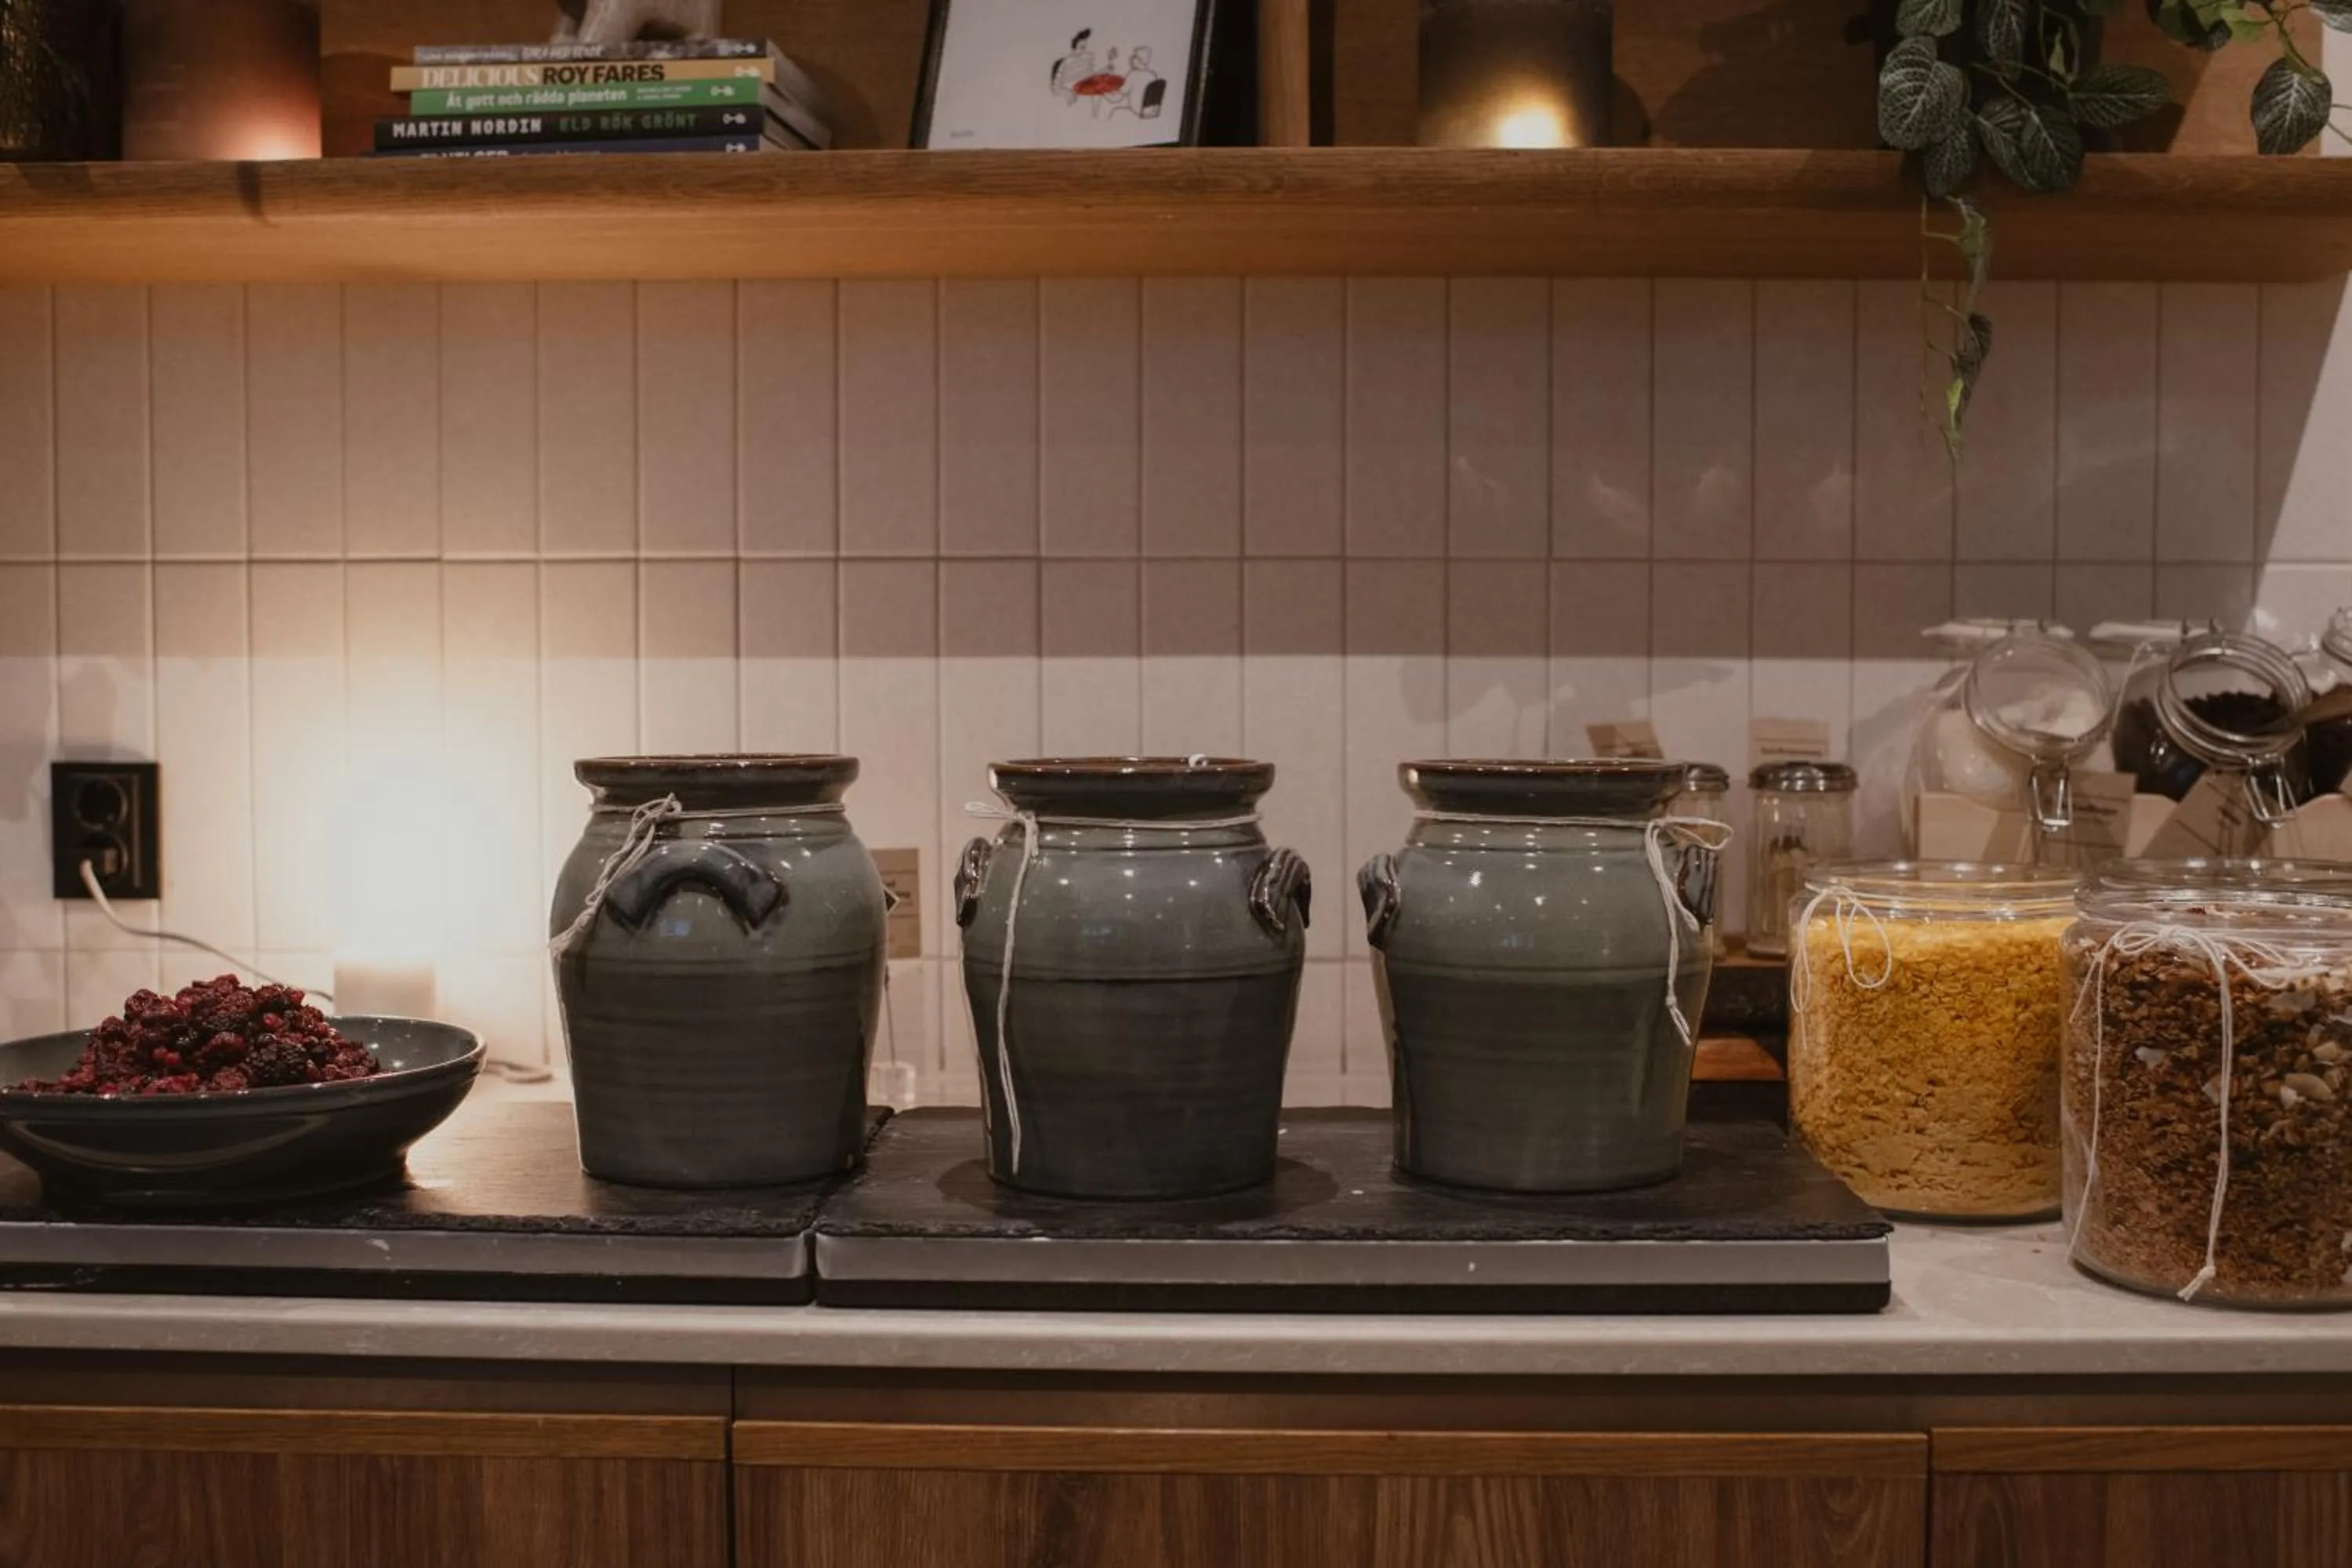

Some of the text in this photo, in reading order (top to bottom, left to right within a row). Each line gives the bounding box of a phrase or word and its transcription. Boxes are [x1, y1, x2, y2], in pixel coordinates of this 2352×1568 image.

[543, 65, 589, 85] ROY
[593, 64, 666, 84] FARES
[466, 93, 495, 111] gott
[497, 93, 523, 105] och
[525, 91, 565, 104] rädda
[568, 88, 627, 107] planeten
[393, 120, 463, 138] MARTIN
[471, 118, 542, 136] NORDIN
[559, 117, 592, 132] ELD
[640, 111, 698, 129] GRÖNT
